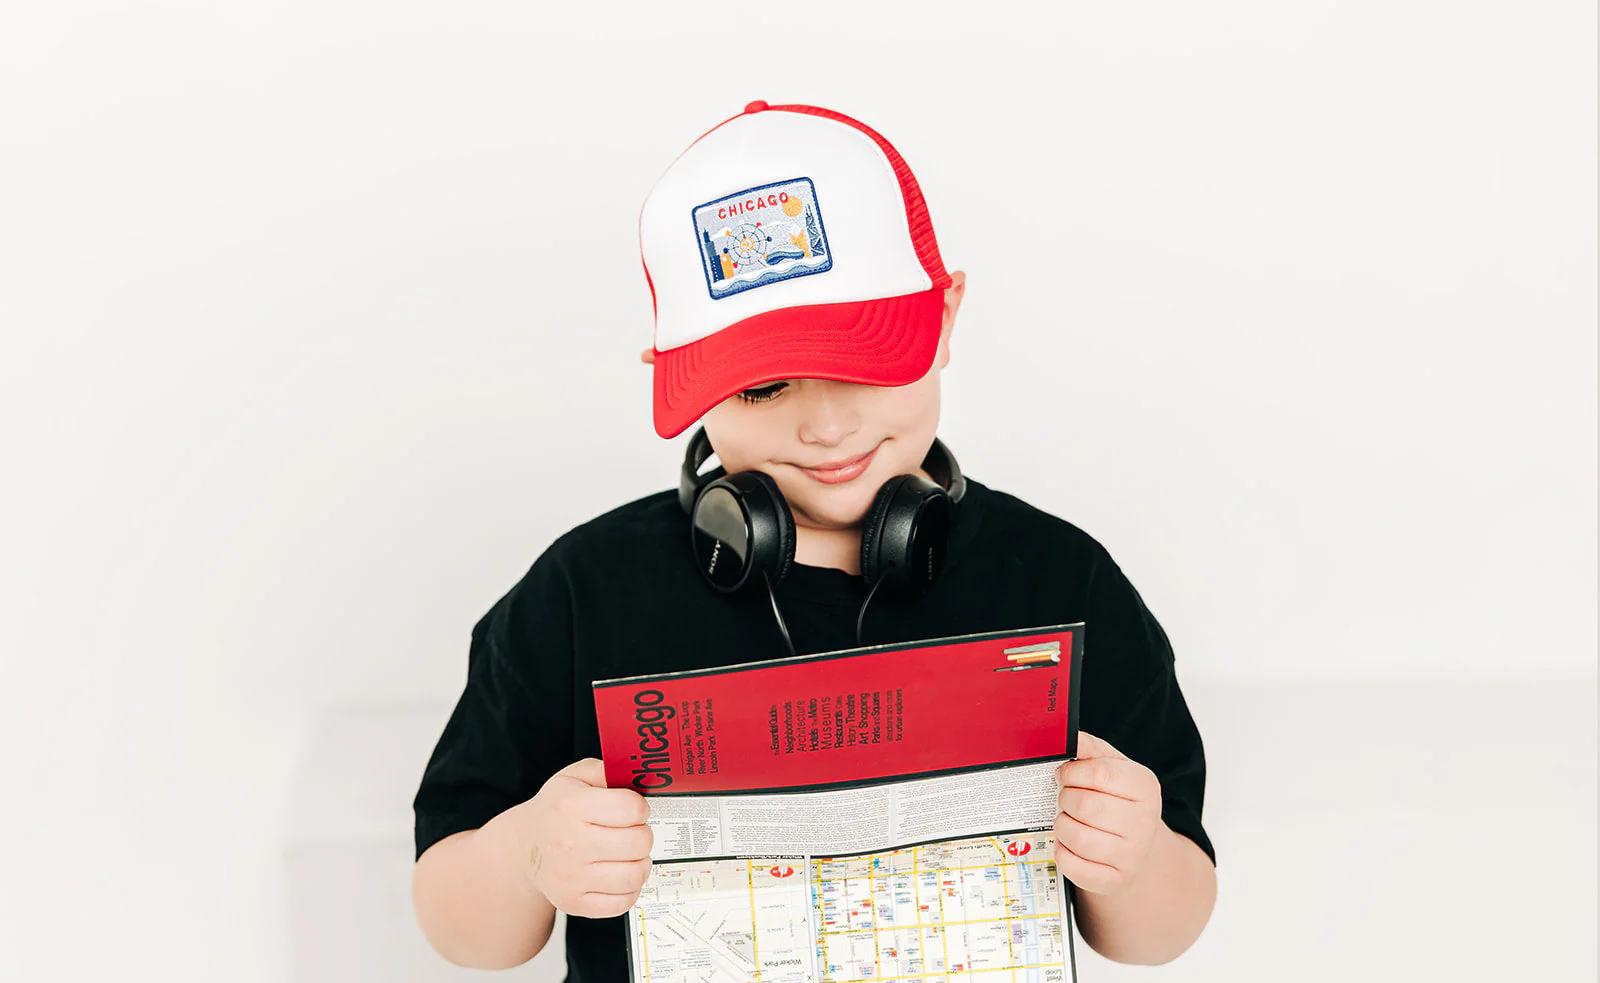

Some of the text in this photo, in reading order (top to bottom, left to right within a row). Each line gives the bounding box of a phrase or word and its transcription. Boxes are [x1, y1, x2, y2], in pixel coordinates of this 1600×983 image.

[717, 191, 790, 219] CHICAGO
[708, 539, 721, 575] SONY
[808, 698, 818, 718] Metro
[871, 691, 882, 716] Squares
[1047, 678, 1058, 712] Red Maps
[784, 701, 796, 754] Neighborhoods
[796, 700, 807, 752] Architecture
[820, 697, 832, 750] Museums
[834, 710, 844, 748] Restaurants
[845, 694, 858, 747] History Theatre
[858, 692, 870, 745] Art Shopping
[872, 726, 881, 744] Parks
[630, 690, 676, 789] Chicago
[682, 701, 695, 775] Michigan Ave The Loop
[693, 700, 707, 774] River North Wicker Park
[708, 735, 717, 750] Park
[809, 728, 819, 751] Hotels
[710, 751, 719, 774] Lincoln
[763, 959, 779, 968] Park
[1045, 968, 1062, 976] Loop
